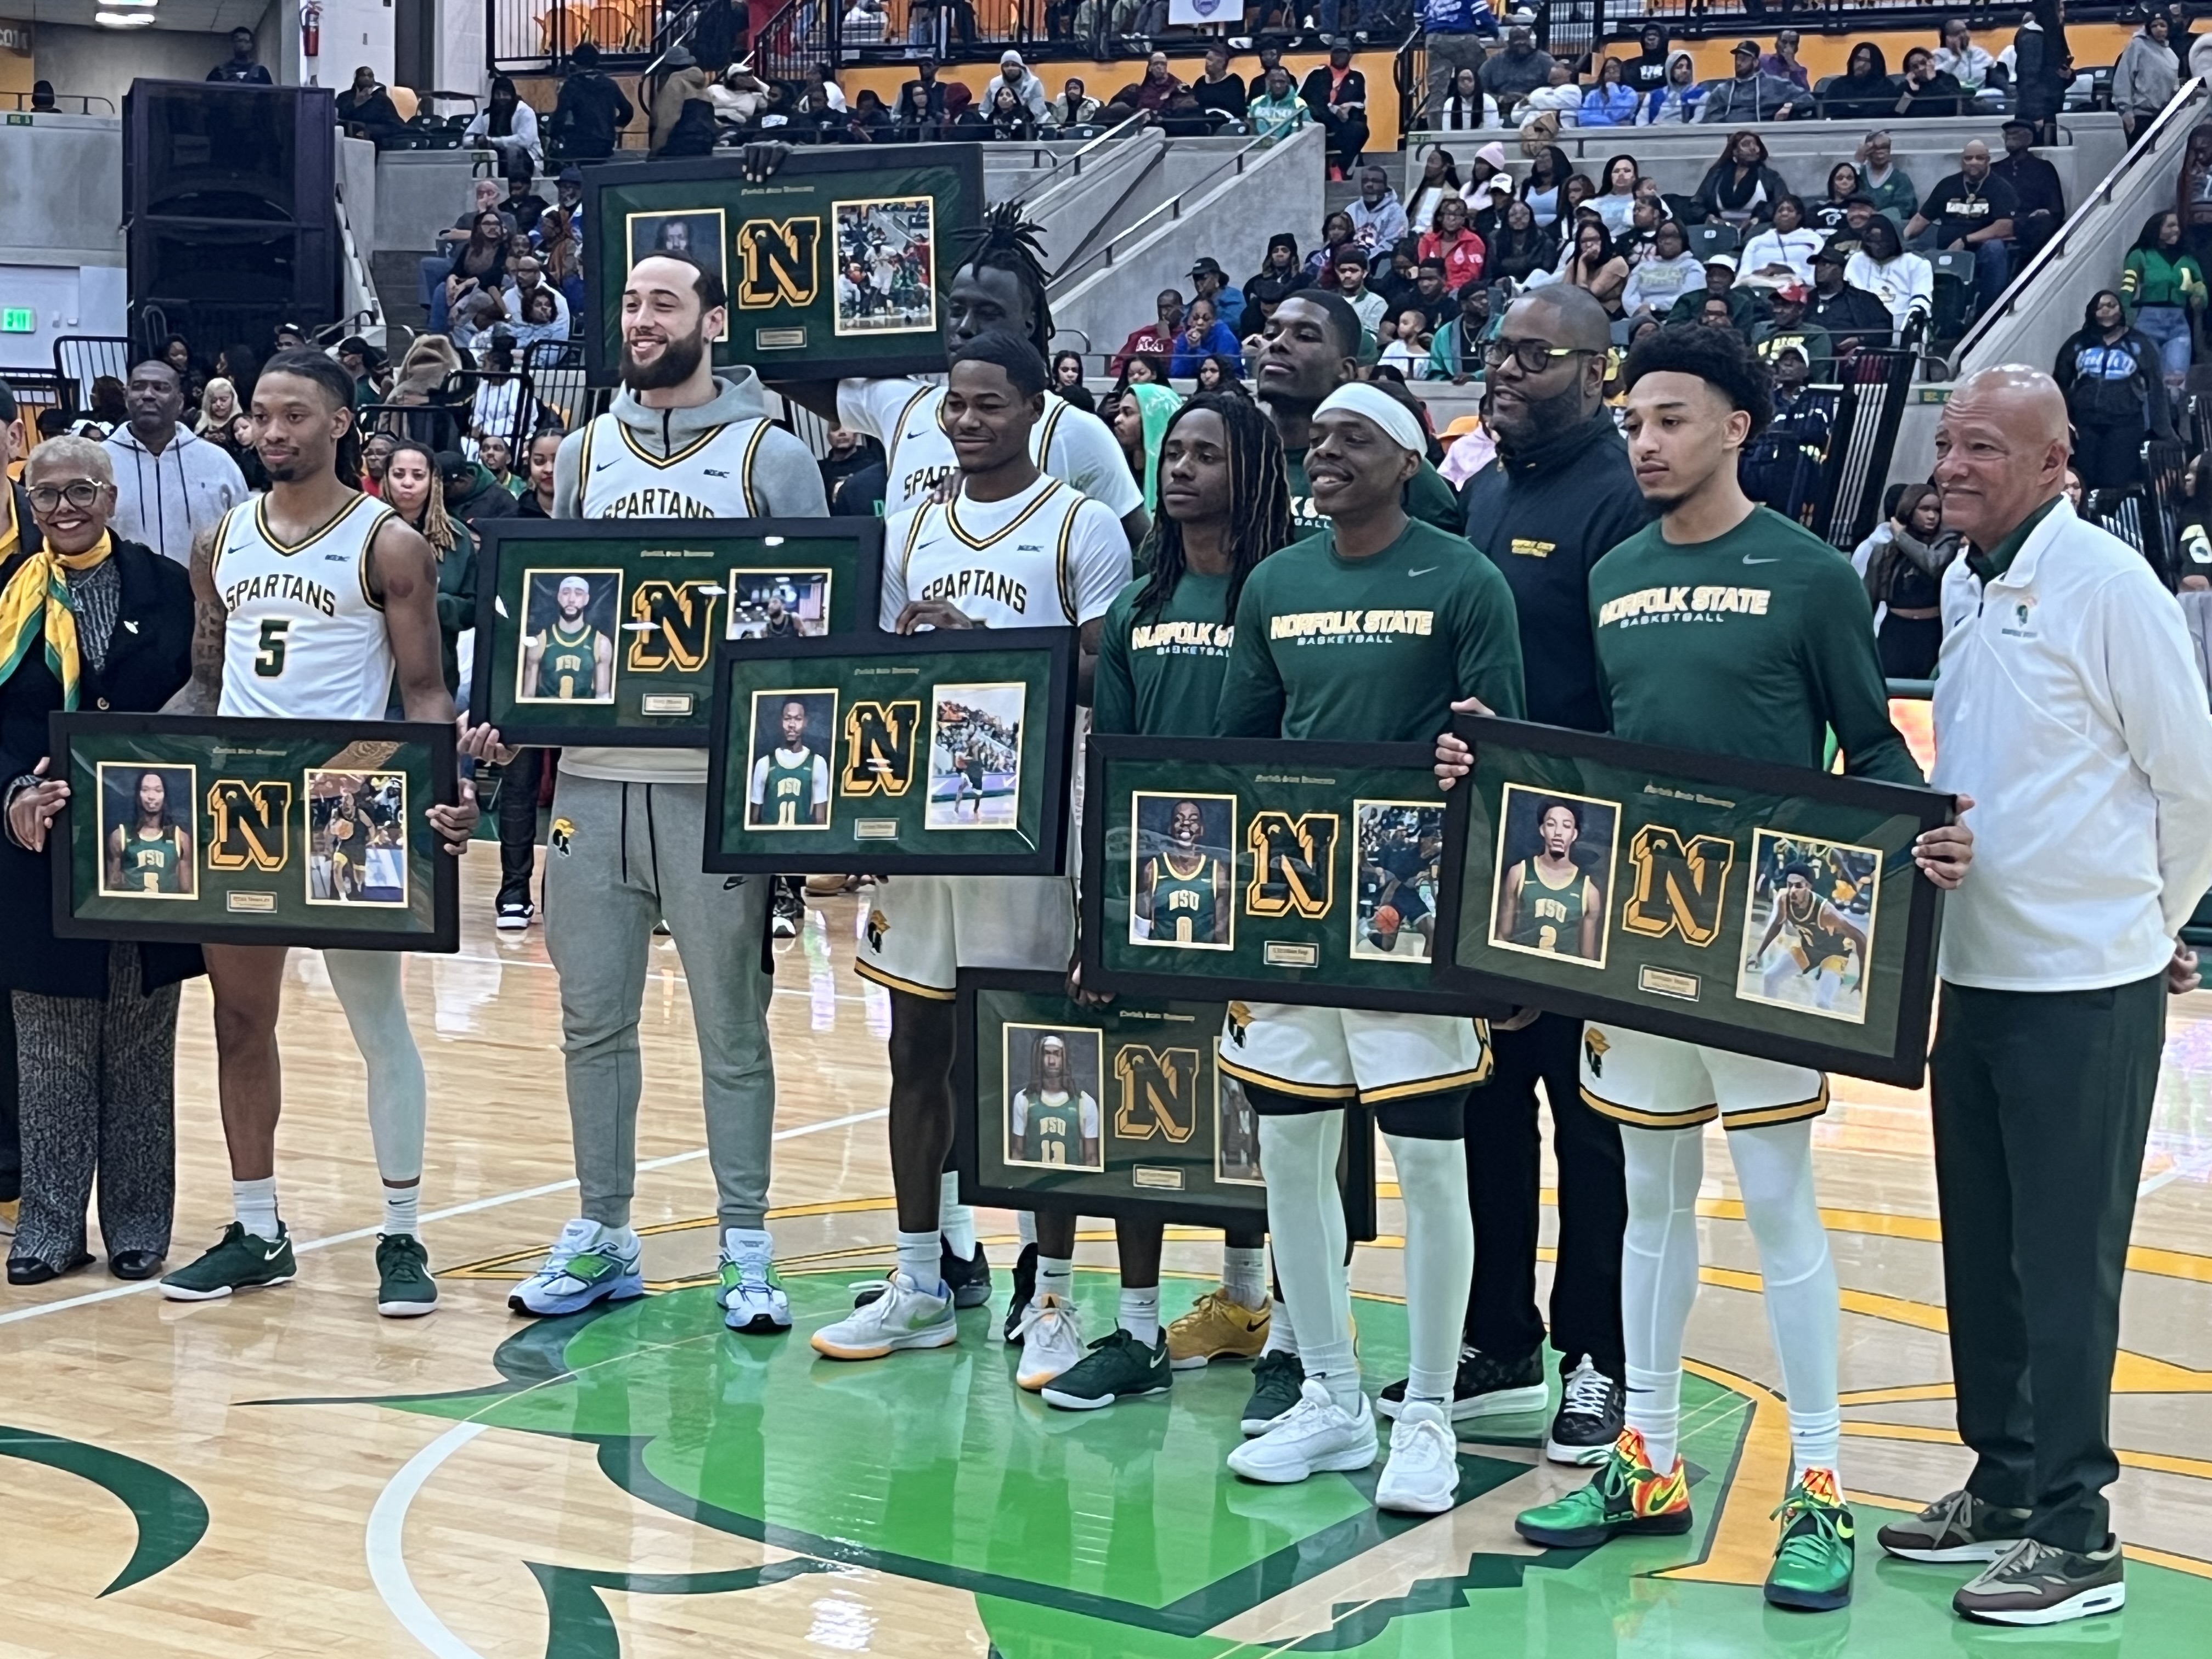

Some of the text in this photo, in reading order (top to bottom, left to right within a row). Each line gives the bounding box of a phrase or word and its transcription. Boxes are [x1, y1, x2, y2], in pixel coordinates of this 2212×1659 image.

[738, 217, 820, 309] N
[224, 574, 336, 617] SPARTANS
[628, 580, 717, 672] N
[922, 569, 1027, 615] SPARTANS
[1271, 610, 1434, 640] NORFOLK STATE
[1599, 585, 1771, 628] NORFOLK STATE
[1620, 612, 1724, 629] BASKETBALL
[254, 618, 291, 677] 5
[1296, 634, 1393, 646] BASKETBALL
[840, 701, 921, 797] N
[207, 780, 291, 872] N
[1246, 811, 1339, 919] N
[1622, 824, 1734, 947] N
[1115, 1044, 1199, 1143] N
